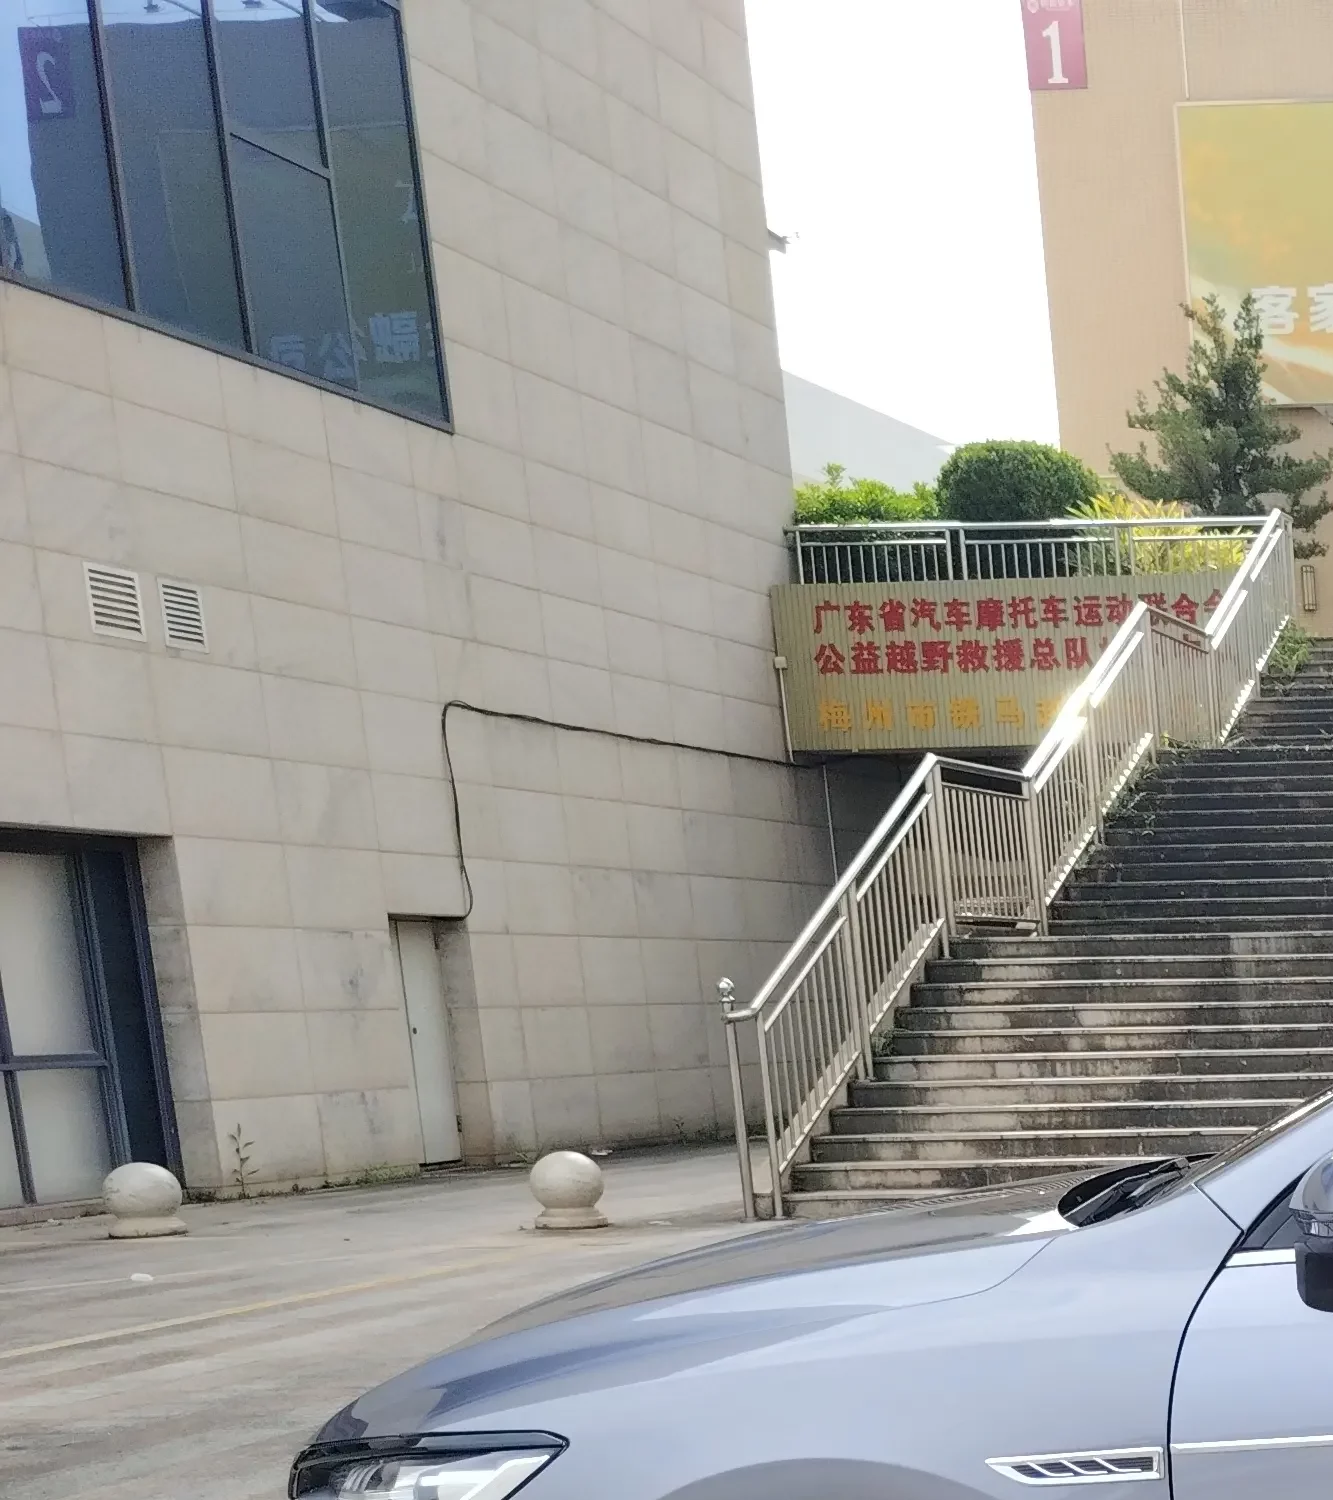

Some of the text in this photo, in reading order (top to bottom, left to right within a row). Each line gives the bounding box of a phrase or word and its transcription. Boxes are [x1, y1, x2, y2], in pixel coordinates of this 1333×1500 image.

[1042, 20, 1069, 84] 1
[814, 636, 1108, 676] 公益越野救援总队
